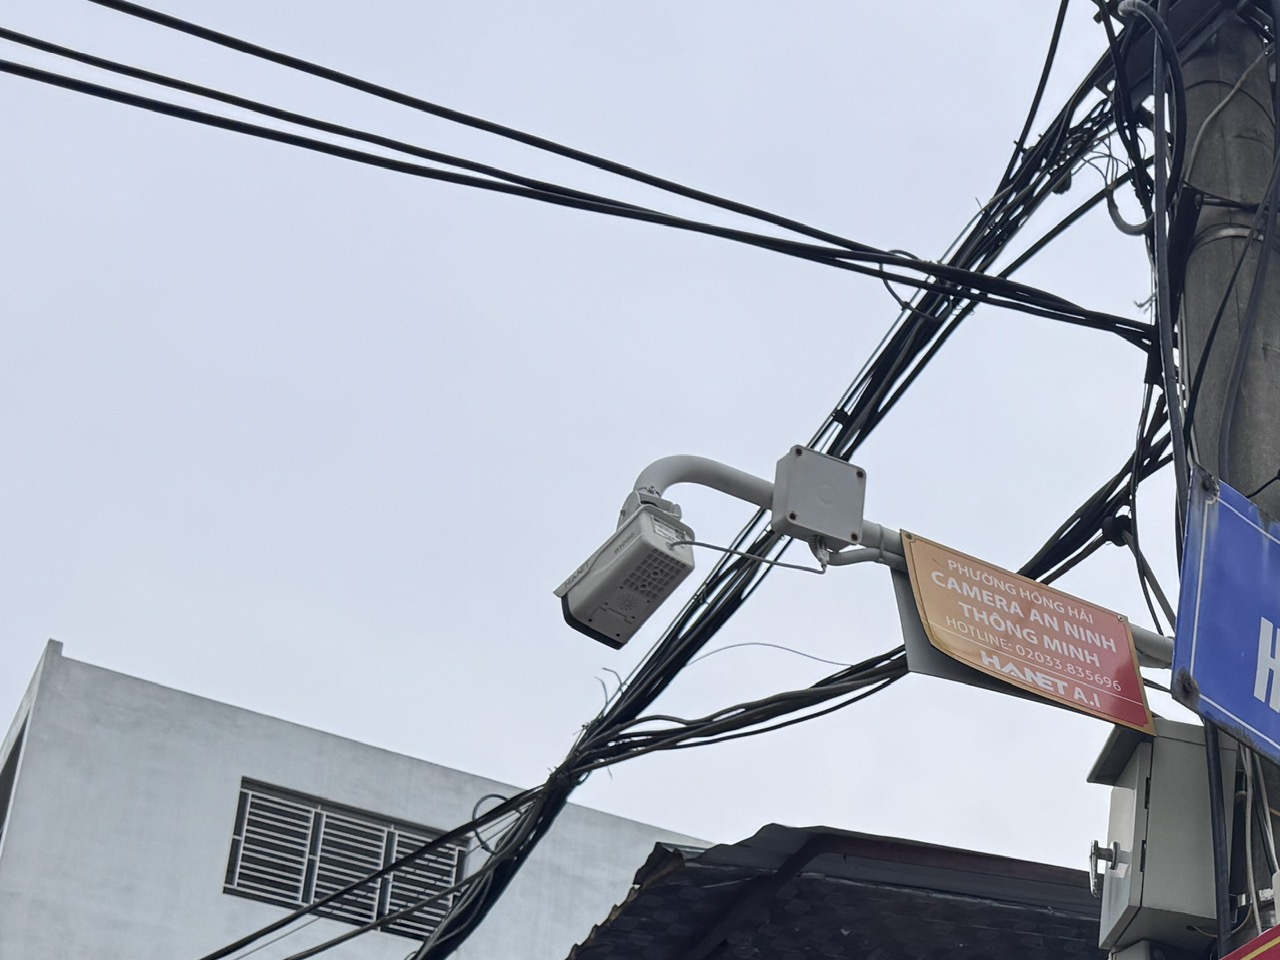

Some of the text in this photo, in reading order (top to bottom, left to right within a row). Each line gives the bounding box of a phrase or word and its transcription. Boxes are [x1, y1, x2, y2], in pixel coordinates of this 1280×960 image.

[931, 570, 1117, 653] CAMERA AN NINH
[948, 559, 1017, 595] PHƯỜNG
[1067, 605, 1094, 624] HẢI
[946, 615, 1122, 692] HOTLINE: 02033.835696
[958, 601, 1101, 668] THÔNG MINH
[980, 650, 1102, 708] HANET A.I
